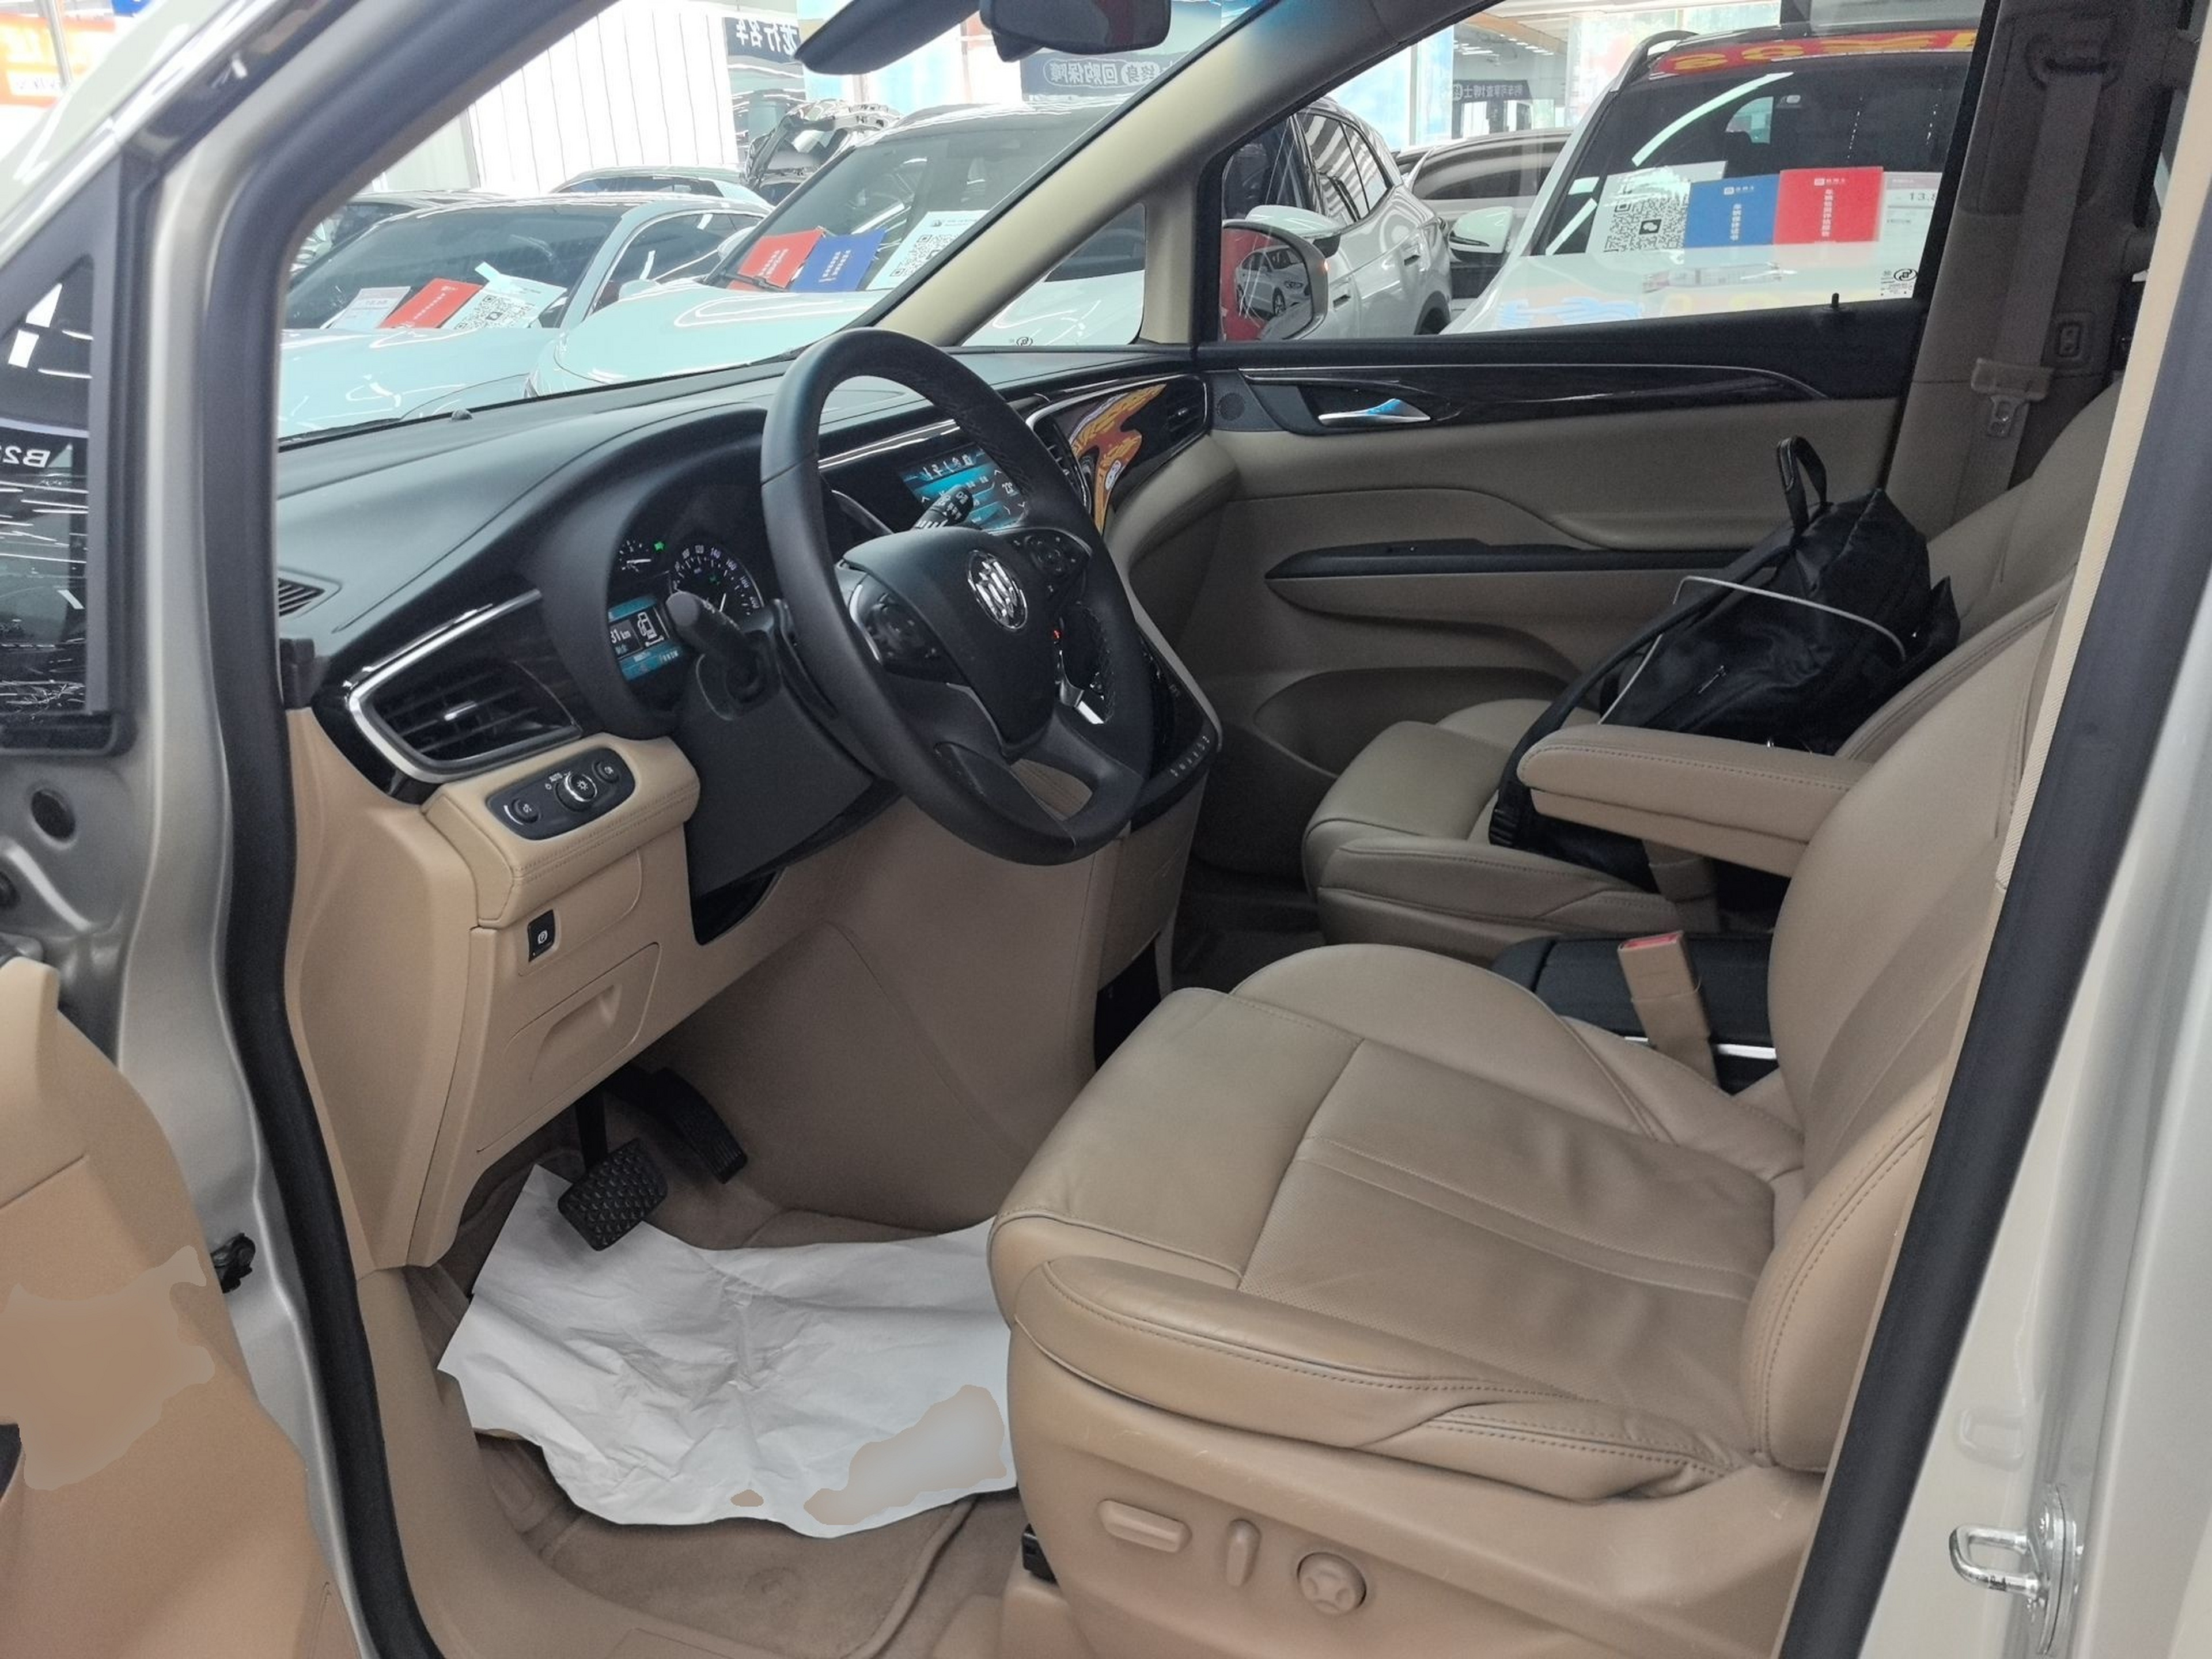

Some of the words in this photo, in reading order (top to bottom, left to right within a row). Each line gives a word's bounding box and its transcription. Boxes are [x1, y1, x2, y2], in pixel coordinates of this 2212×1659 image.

[710, 547, 721, 559] 140
[726, 558, 737, 571] 160
[740, 575, 749, 588] 180
